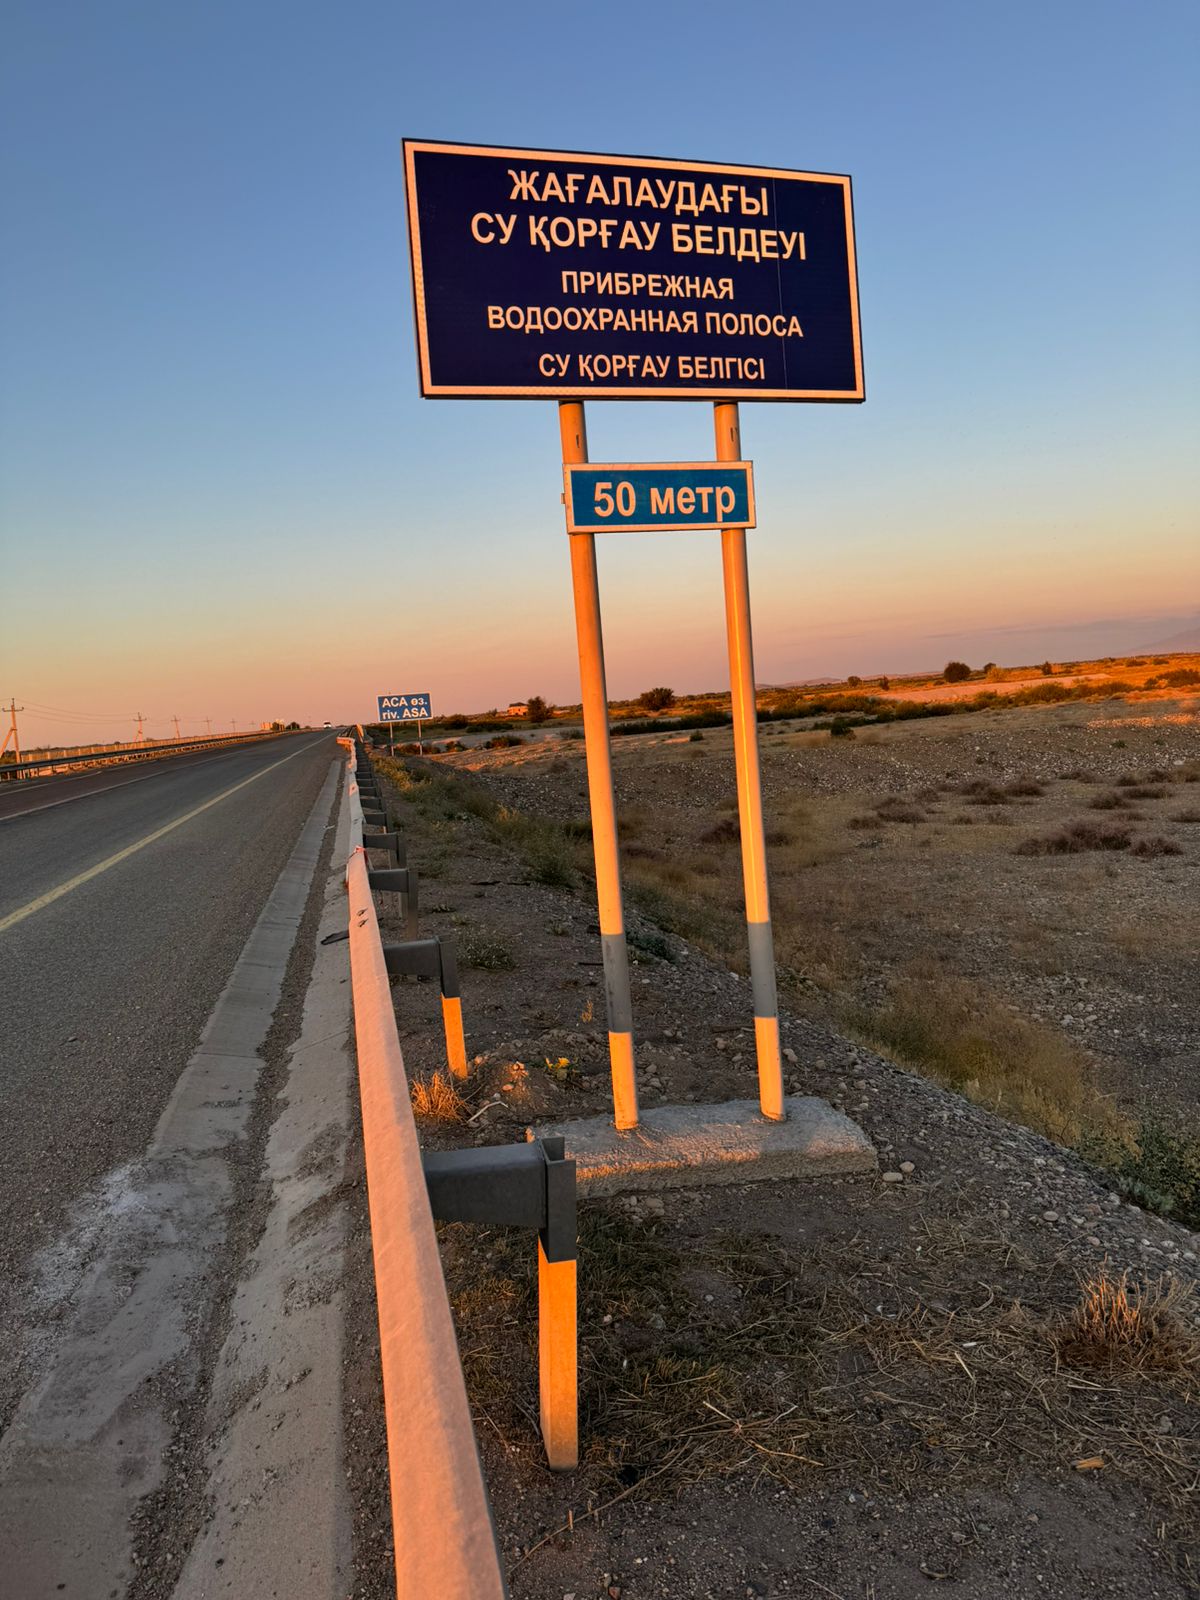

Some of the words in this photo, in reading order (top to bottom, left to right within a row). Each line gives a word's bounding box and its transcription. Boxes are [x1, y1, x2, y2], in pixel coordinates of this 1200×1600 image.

[508, 169, 768, 216] ЖАҒАЛАУДАҒЫ
[471, 213, 517, 245] СУ
[529, 215, 661, 252] ҚОРҒАУ
[672, 223, 806, 262] БЕЛДЕУІ
[562, 271, 734, 300] ПРИБРЕЖНАЯ
[488, 306, 698, 334] ВОДООХРАННАЯ
[705, 312, 803, 337] ПОЛОСА
[539, 354, 570, 377] СУ
[579, 354, 671, 382] ҚОРҒАУ
[679, 356, 765, 380] БЕЛГІСІ
[594, 481, 636, 518] 50
[650, 485, 735, 522] метр
[382, 697, 408, 708] АСА
[382, 710, 400, 719] riv.
[403, 707, 428, 718] ASA
